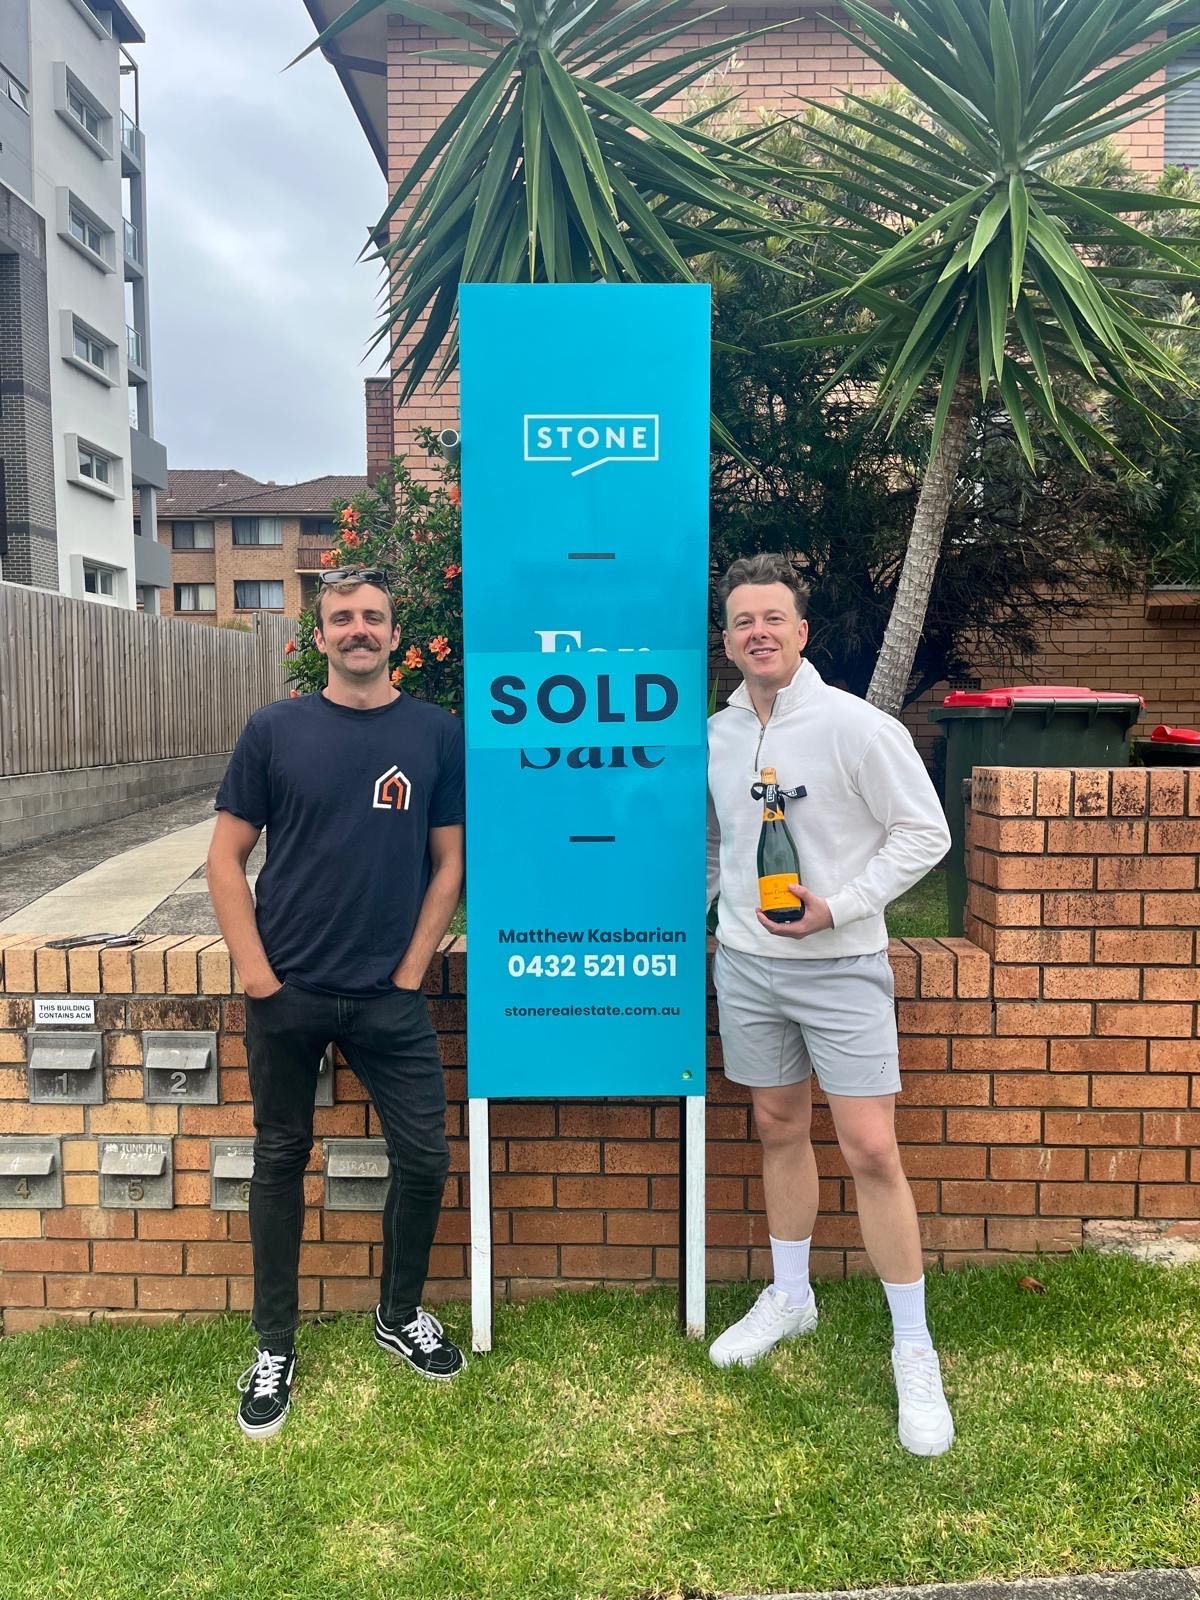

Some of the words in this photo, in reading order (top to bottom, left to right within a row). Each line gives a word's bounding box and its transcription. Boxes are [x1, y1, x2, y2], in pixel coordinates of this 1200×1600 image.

[537, 426, 647, 449] STONE
[490, 673, 679, 725] SOLD
[498, 928, 585, 944] Matthew
[587, 926, 687, 944] Kasbarian
[508, 955, 576, 977] 0432
[584, 954, 625, 977] 521
[632, 954, 676, 977] 051
[504, 1004, 681, 1018] stonerealestate.com.au
[56, 1072, 68, 1096] 1
[170, 1071, 187, 1094] 2
[15, 1177, 31, 1200] 4
[128, 1179, 144, 1201] 5
